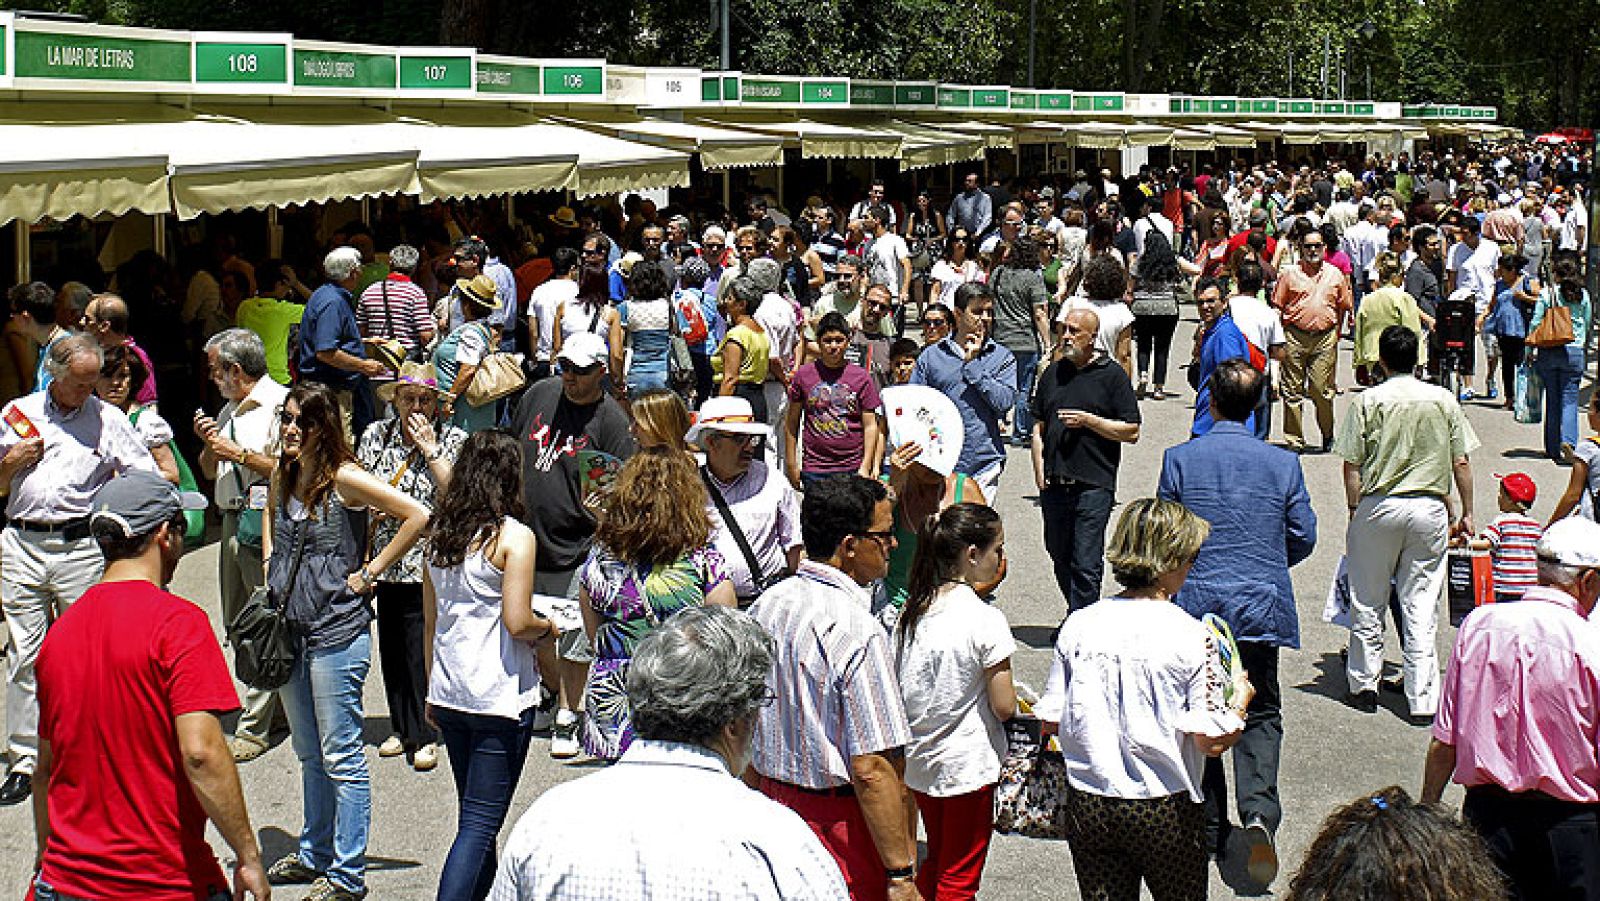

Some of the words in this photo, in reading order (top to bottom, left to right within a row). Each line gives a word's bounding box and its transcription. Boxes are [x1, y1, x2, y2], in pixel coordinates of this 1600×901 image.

[47, 46, 61, 66] LA
[62, 47, 84, 67] MAR
[86, 48, 99, 68] DE
[100, 49, 134, 69] LETRAS
[228, 54, 257, 72] 108
[424, 65, 447, 80] 107
[563, 74, 583, 88] 106
[666, 80, 682, 93] 105
